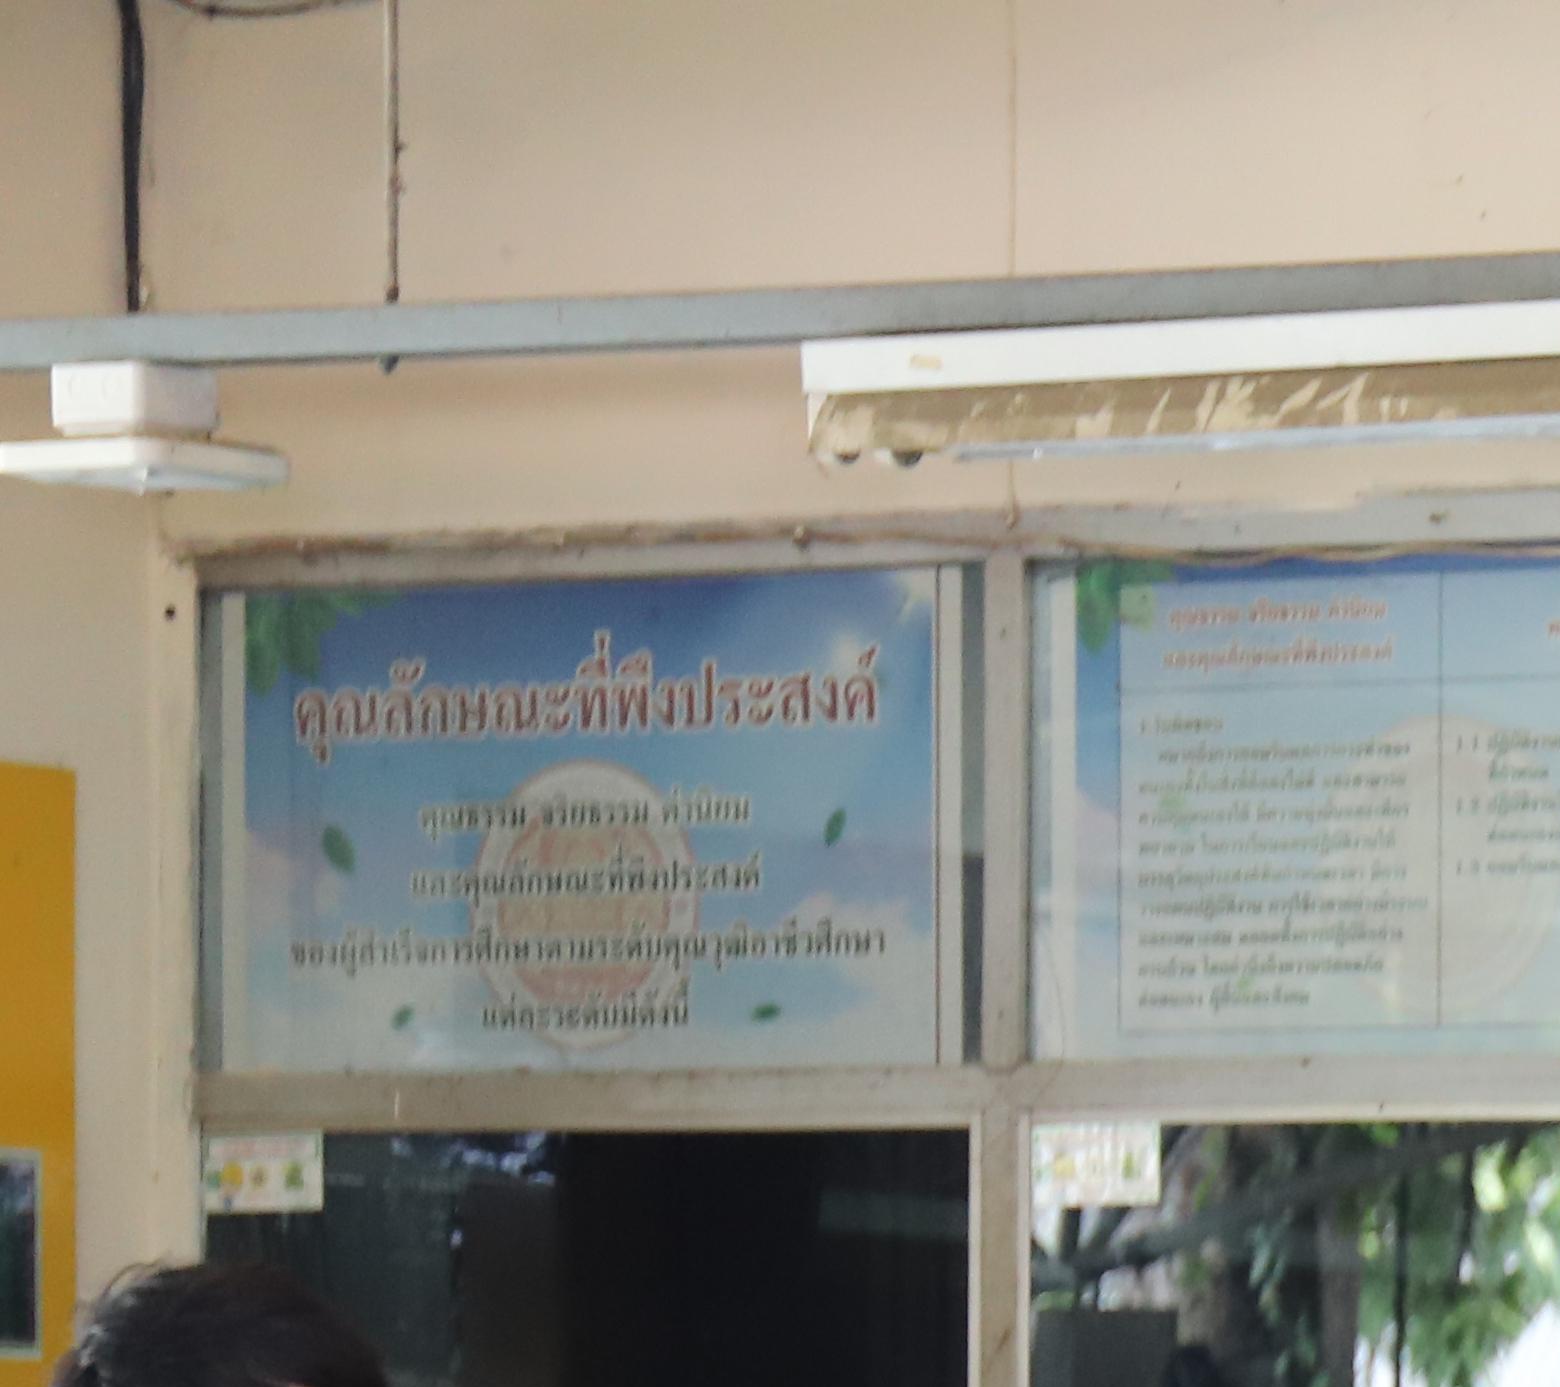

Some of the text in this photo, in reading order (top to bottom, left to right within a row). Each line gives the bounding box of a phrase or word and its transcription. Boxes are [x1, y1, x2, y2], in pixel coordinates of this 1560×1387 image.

[294, 629, 878, 763] คุณลักษณะที่พึงประสงค์
